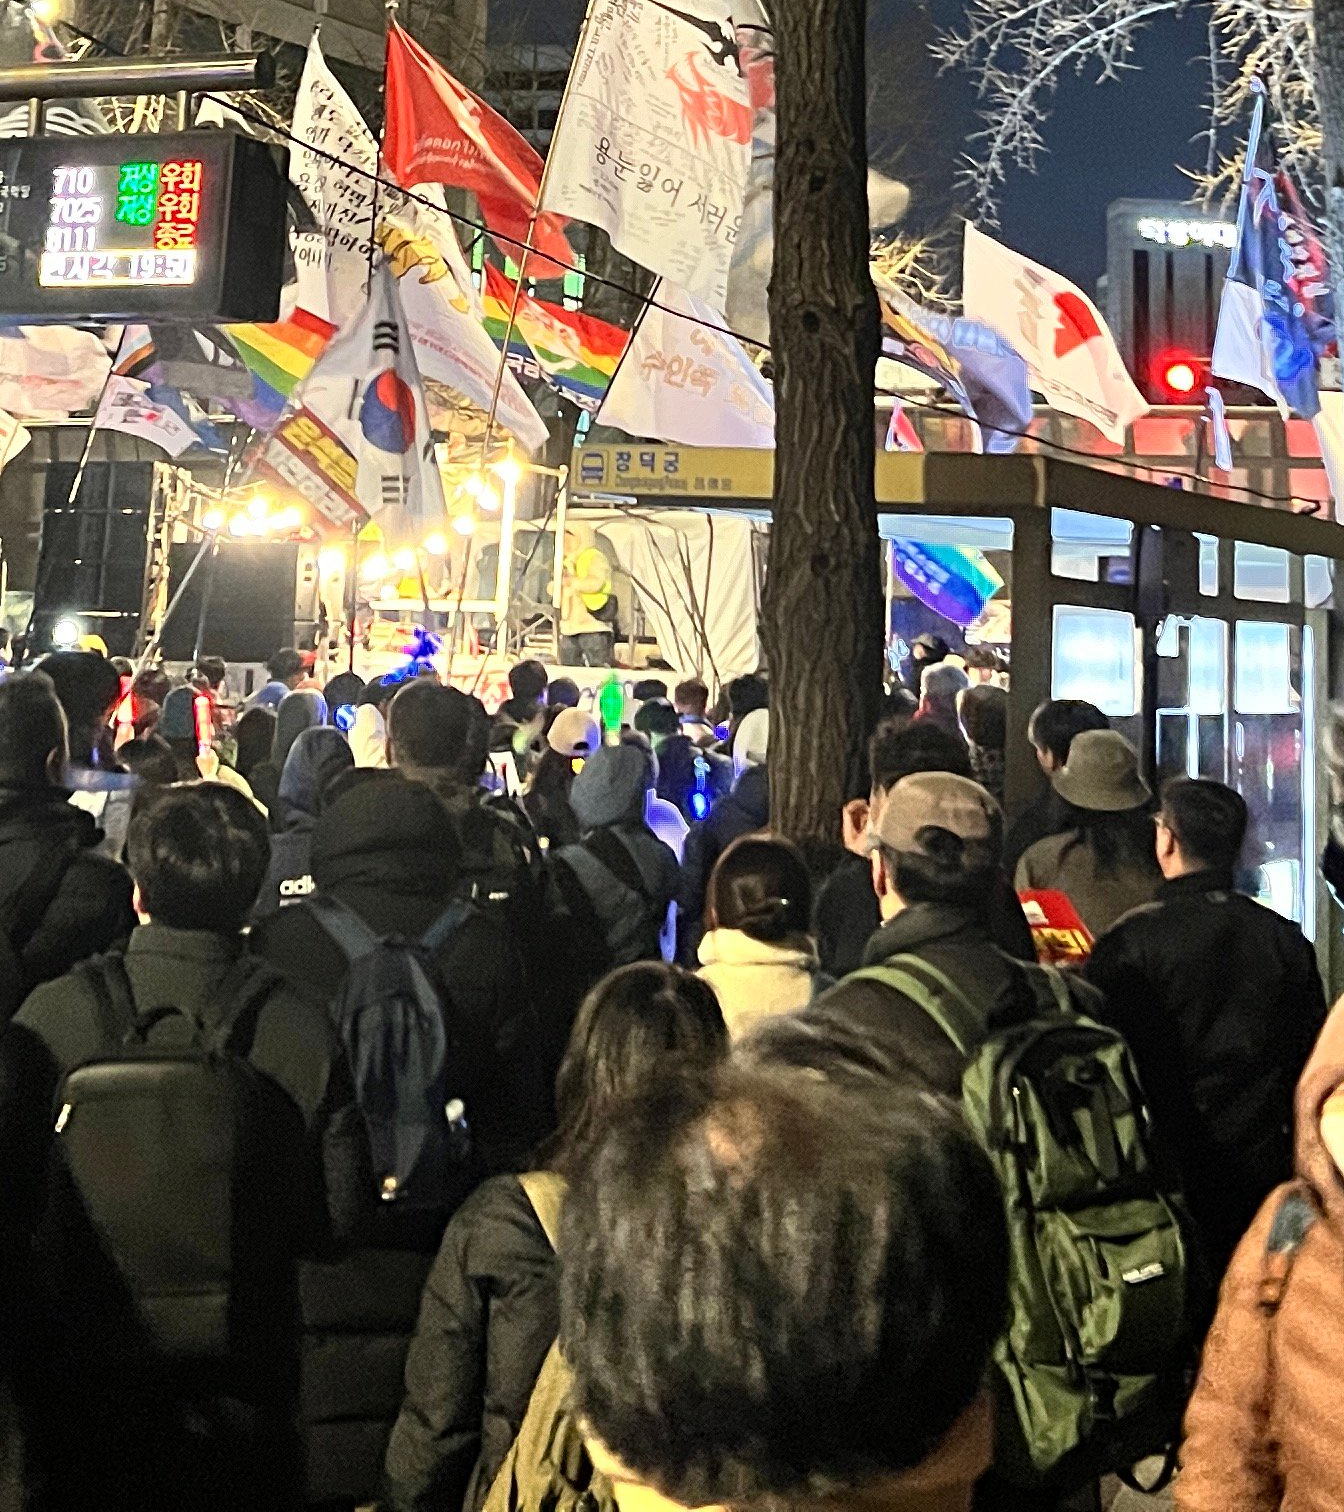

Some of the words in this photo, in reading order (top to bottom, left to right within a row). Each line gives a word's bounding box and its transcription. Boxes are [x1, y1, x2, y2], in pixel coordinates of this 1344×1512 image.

[52, 167, 96, 195] 710
[119, 163, 158, 194] 저상
[160, 162, 203, 192] 우회
[49, 196, 104, 224] 7025
[116, 194, 154, 224] 저상
[157, 193, 200, 223] 우회
